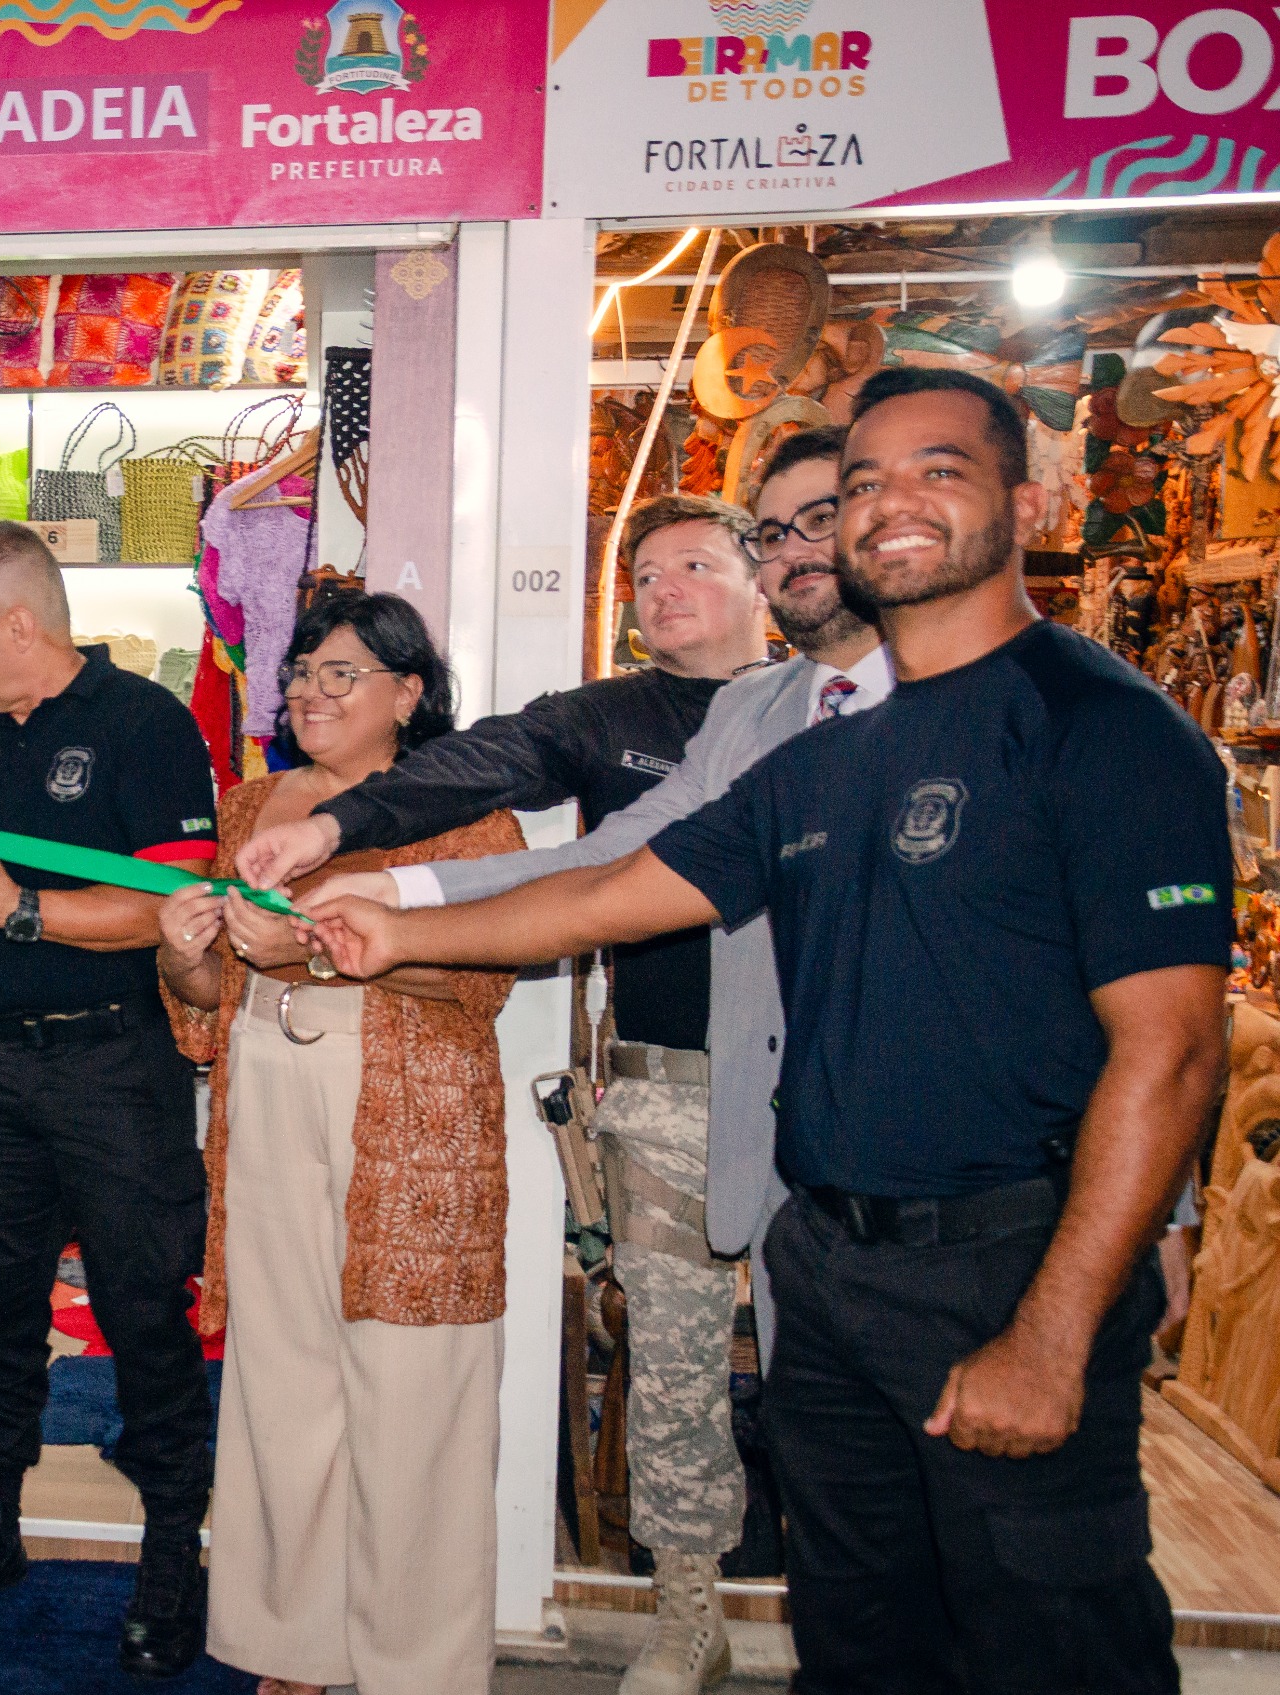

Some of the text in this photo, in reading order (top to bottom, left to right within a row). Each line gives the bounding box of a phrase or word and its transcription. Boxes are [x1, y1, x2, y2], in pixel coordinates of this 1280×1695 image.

[329, 70, 397, 84] FORTITUDINE
[687, 75, 866, 103] DE TODOS
[241, 97, 483, 148] Fortaleza
[644, 123, 863, 173] FORTALZA
[271, 157, 444, 181] PREFEITURA
[665, 176, 837, 193] CIDADE CRIATIVA
[47, 530, 58, 544] 6
[396, 561, 423, 590] A
[512, 570, 561, 592] 002
